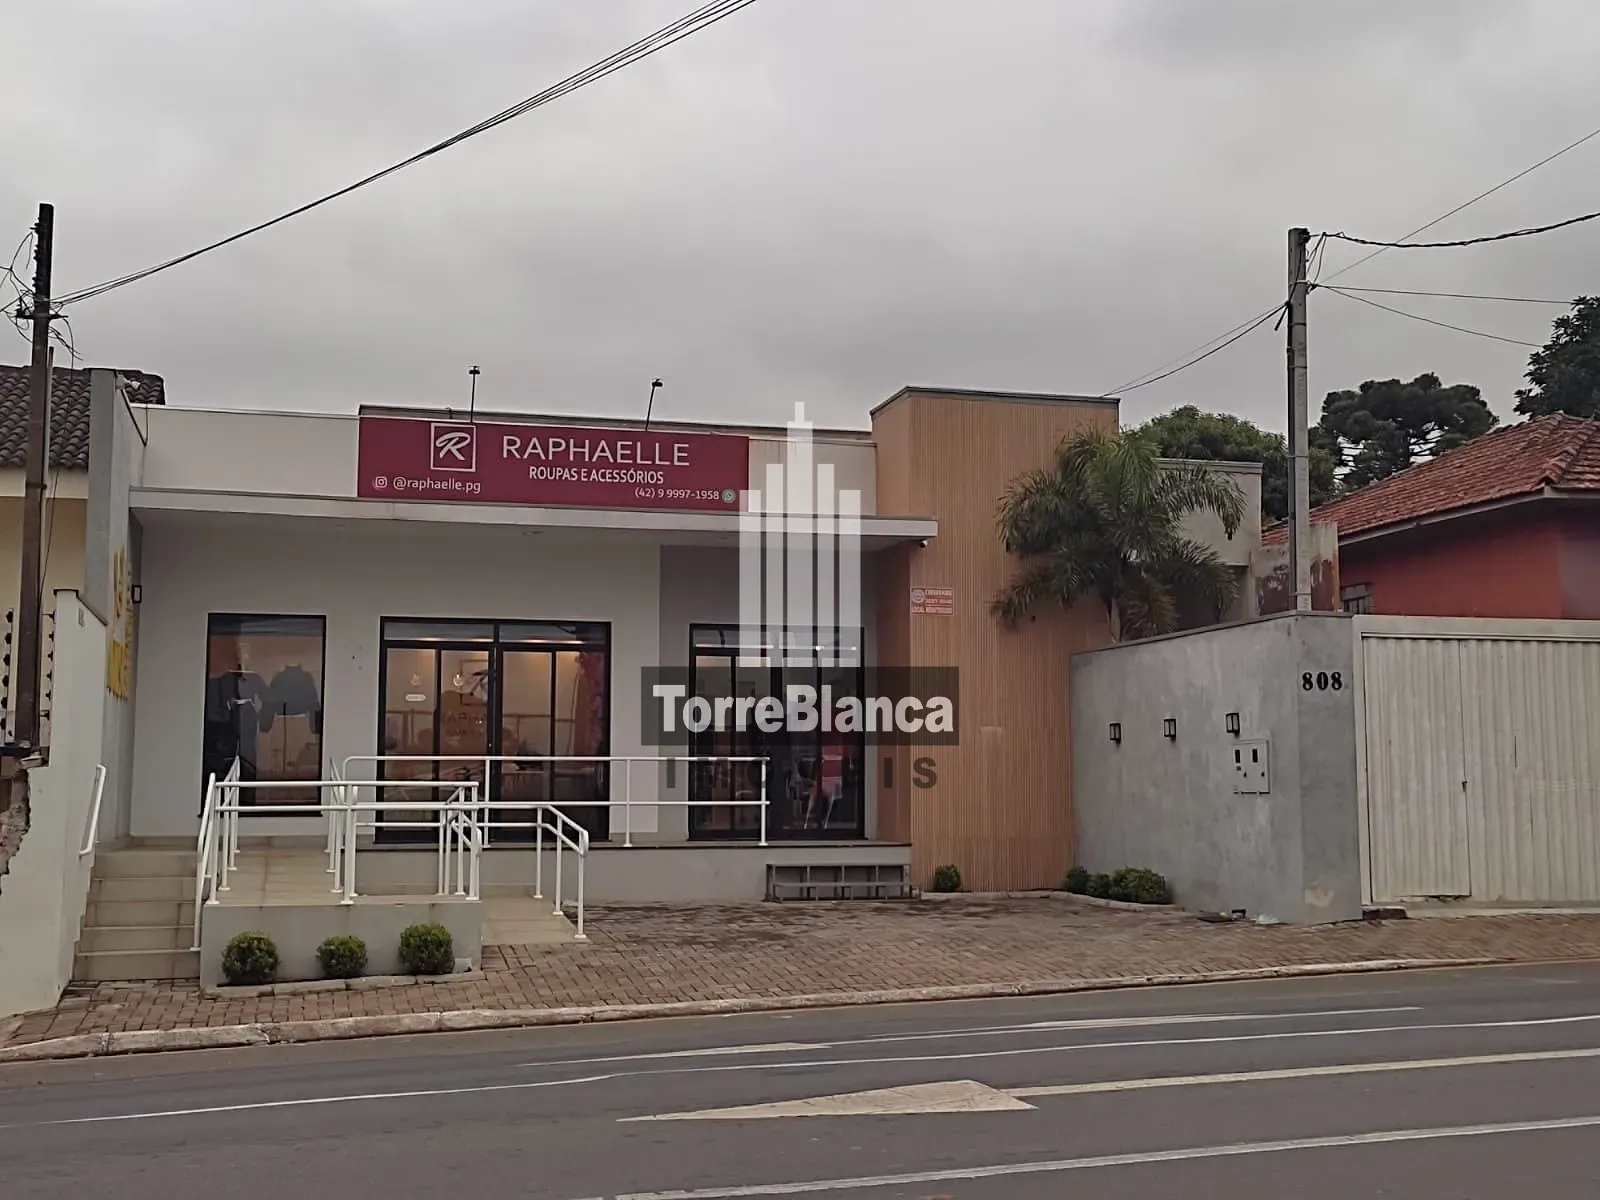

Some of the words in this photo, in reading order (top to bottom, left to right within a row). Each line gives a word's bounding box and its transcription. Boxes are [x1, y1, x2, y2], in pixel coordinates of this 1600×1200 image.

[502, 435, 691, 466] RAPHAELLE
[529, 466, 578, 481] ROUPAS
[581, 468, 588, 481] E
[590, 468, 664, 484] ACESSÓRIOS
[393, 476, 481, 494] @raphaelle.pg
[635, 487, 655, 498] (42)
[658, 488, 664, 498] 9
[666, 489, 720, 500] 9997-1958
[1302, 671, 1343, 691] 808
